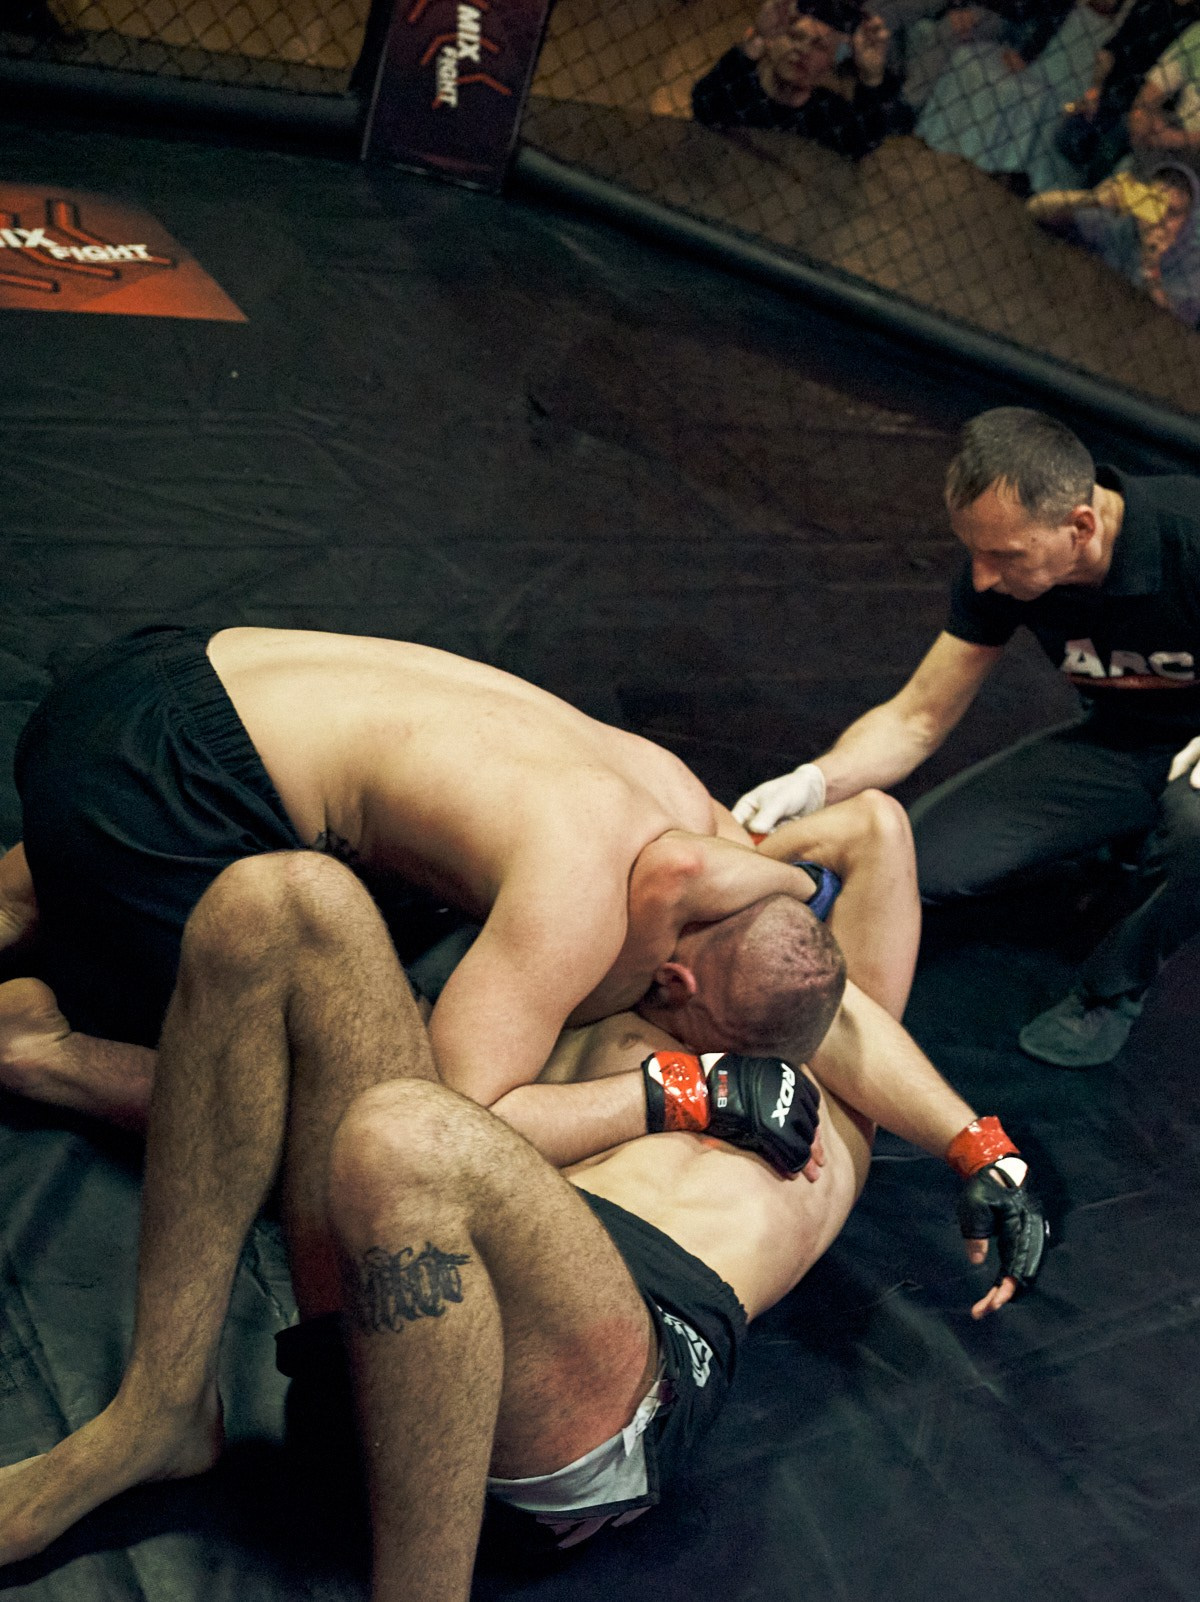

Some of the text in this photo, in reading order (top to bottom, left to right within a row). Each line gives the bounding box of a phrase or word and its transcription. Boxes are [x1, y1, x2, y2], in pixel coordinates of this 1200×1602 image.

[456, 4, 481, 62] MIX
[436, 46, 459, 108] FIGHT
[0, 228, 58, 248] IX
[49, 243, 154, 263] FIGHT
[1060, 637, 1195, 681] ARC
[771, 1063, 796, 1128] RDX
